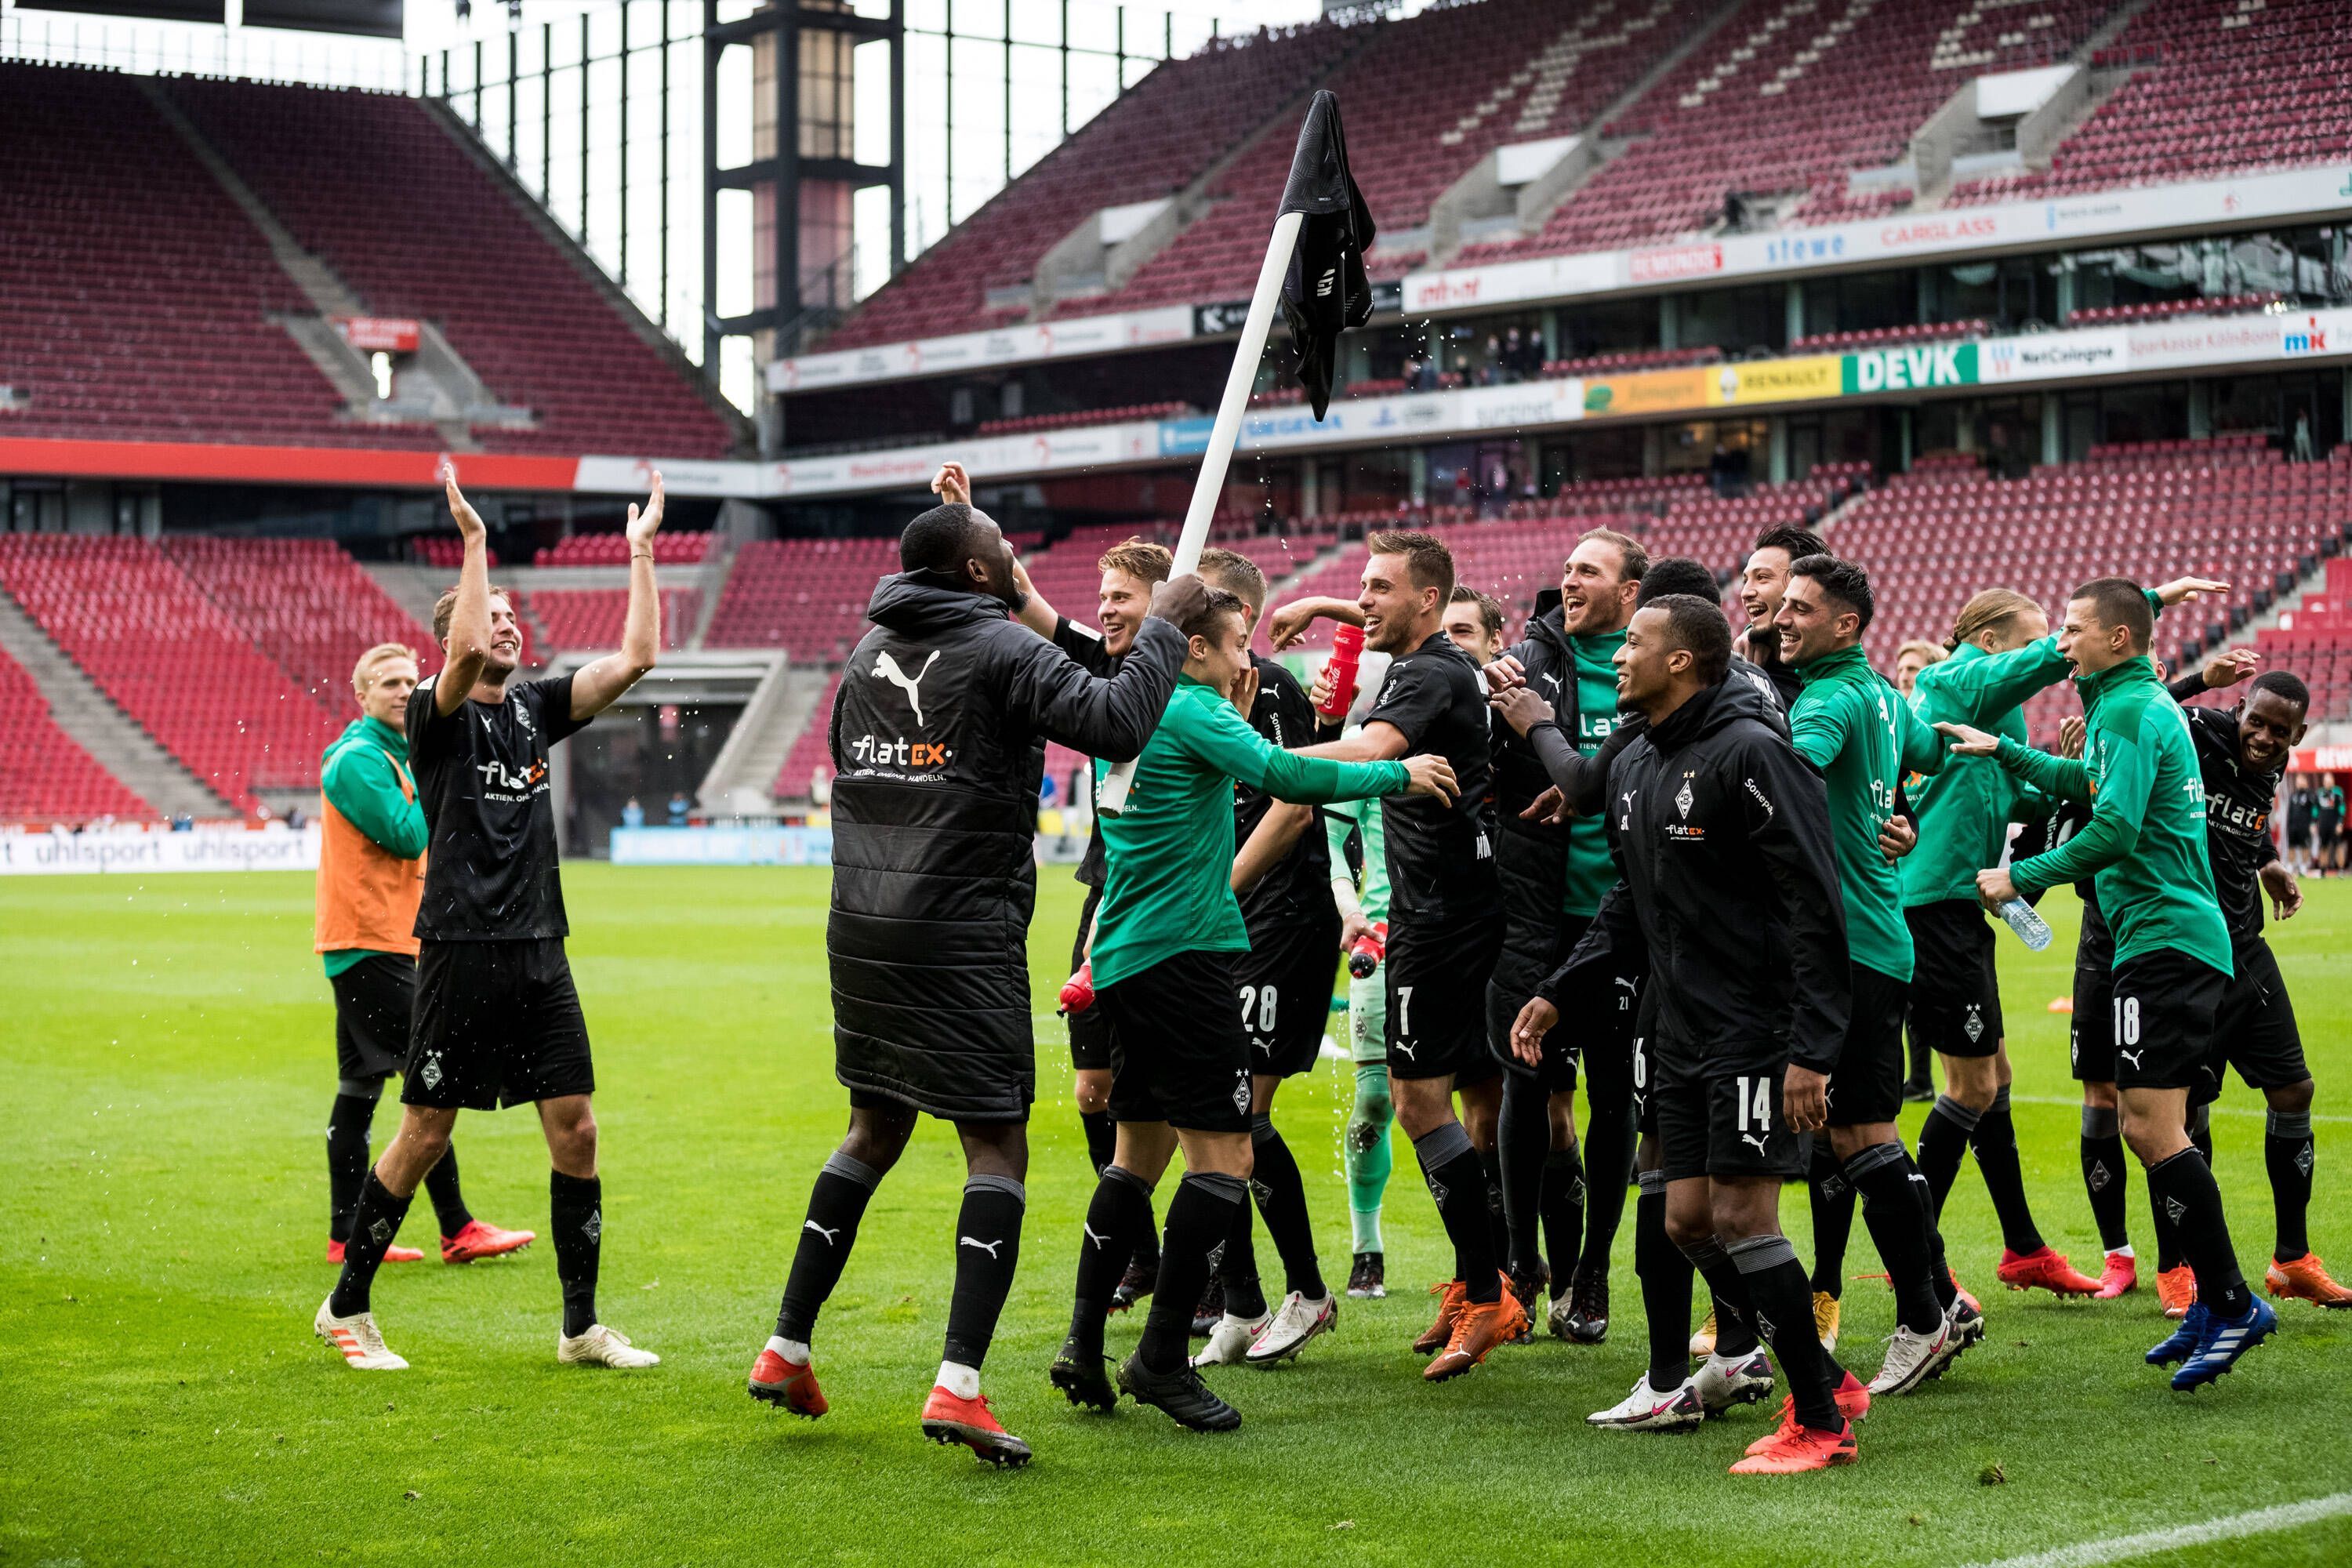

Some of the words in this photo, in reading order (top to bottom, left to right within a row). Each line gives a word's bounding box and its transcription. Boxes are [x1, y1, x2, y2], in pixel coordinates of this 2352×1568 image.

[1744, 366, 1828, 390] RENAULT
[1857, 345, 1961, 392] DEVK
[1269, 712, 1283, 748] Sonepa
[35, 833, 160, 866] uhlsport
[183, 836, 305, 862] uhlsport
[1239, 985, 1278, 1033] 28
[1398, 986, 1414, 1036] 7
[1619, 996, 1629, 1011] 21
[2114, 996, 2140, 1047] 18
[1737, 1076, 1771, 1131] 14
